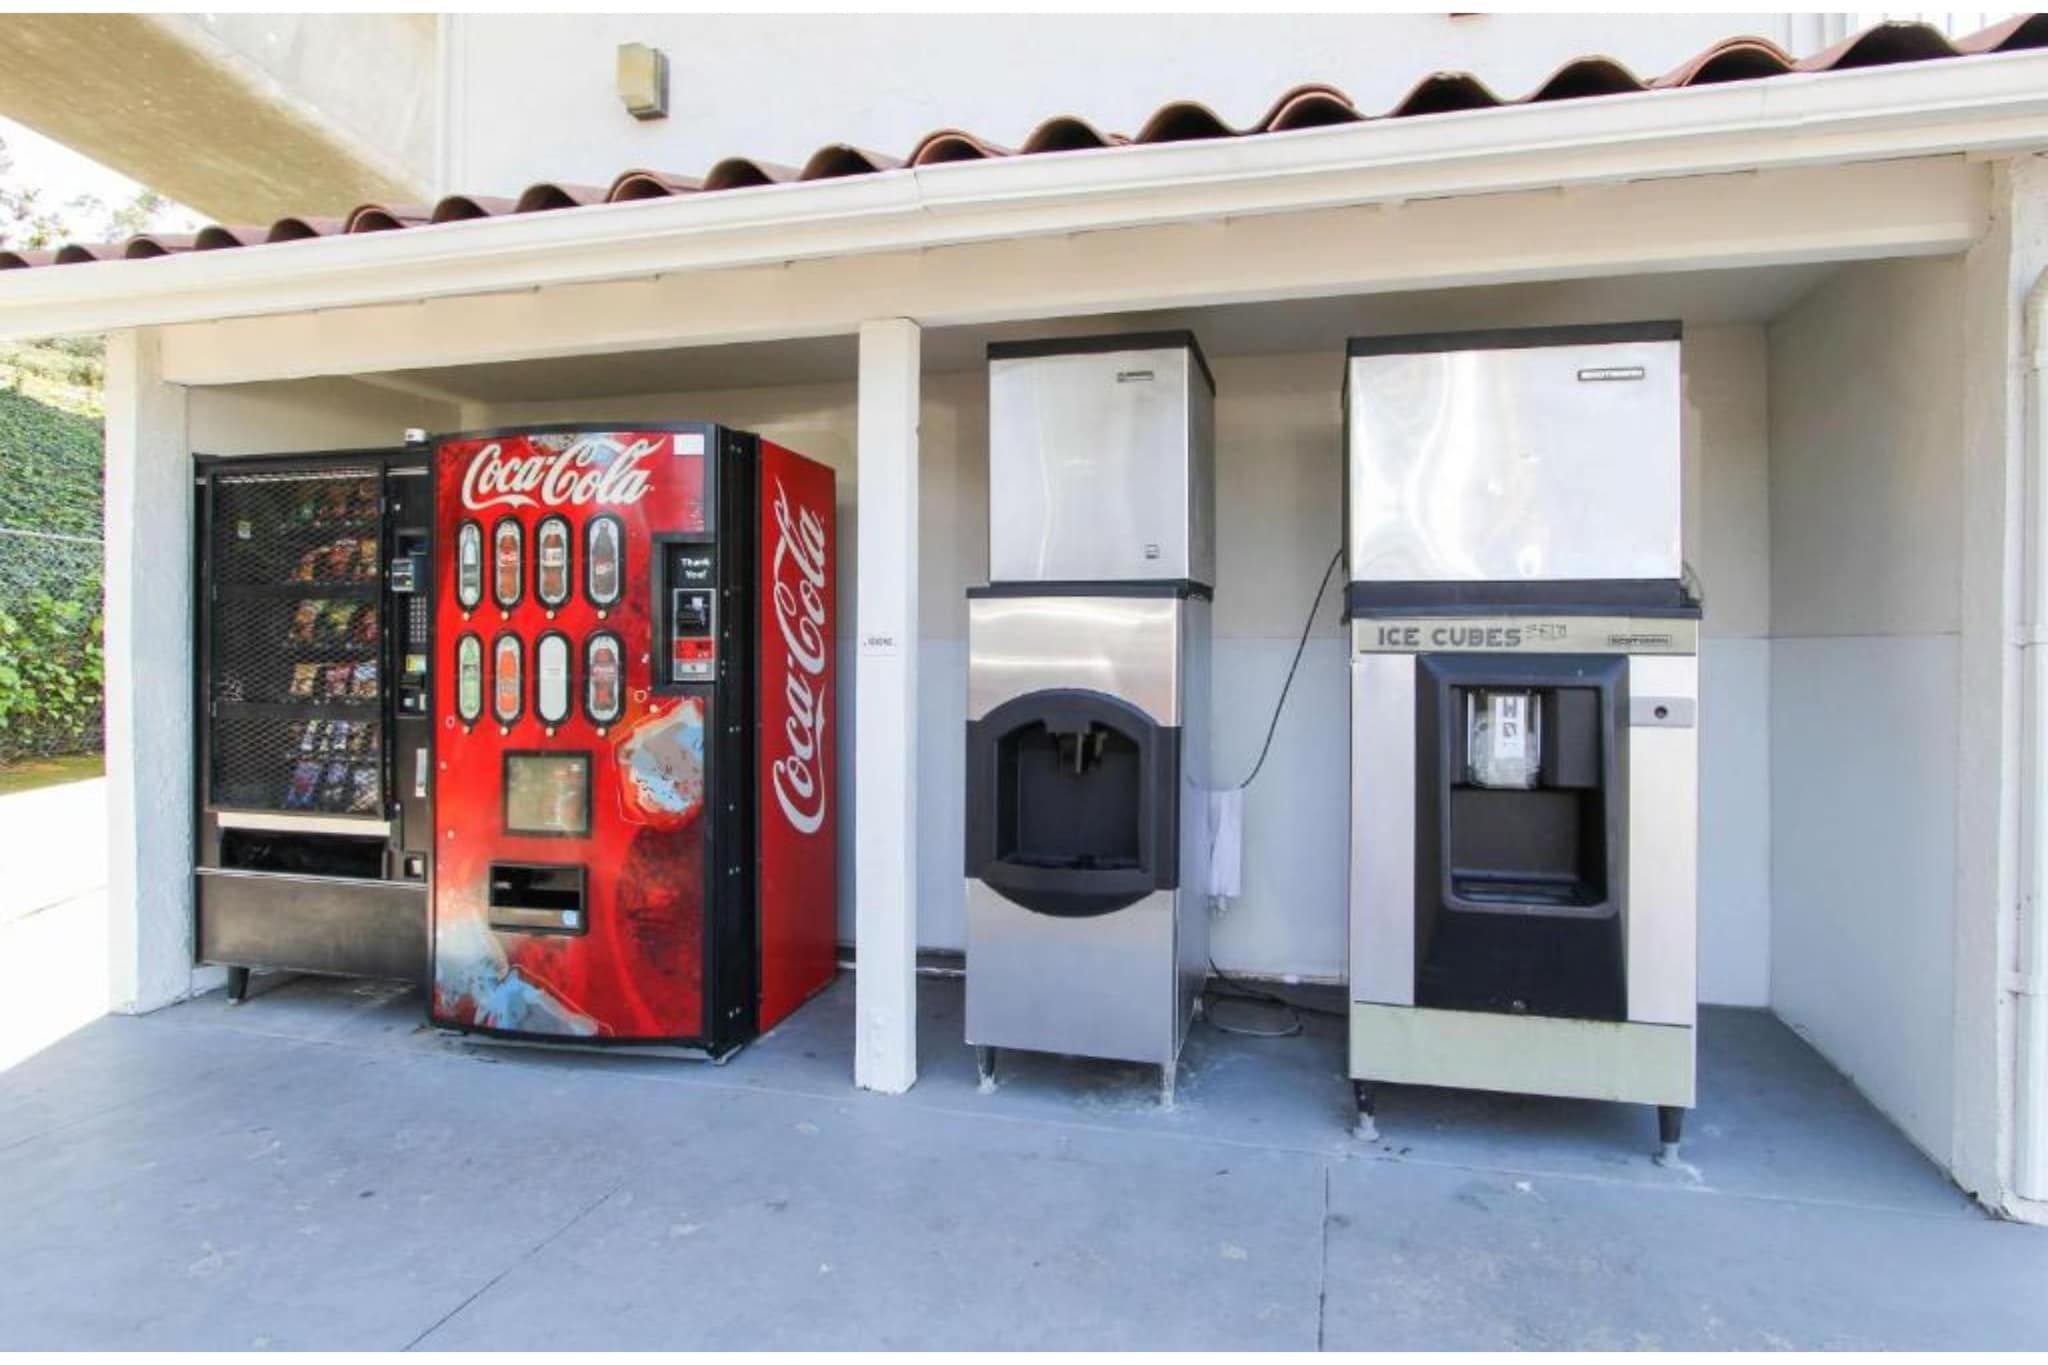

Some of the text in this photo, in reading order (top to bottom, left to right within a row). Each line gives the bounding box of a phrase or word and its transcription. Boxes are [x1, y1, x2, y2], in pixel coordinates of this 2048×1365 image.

[461, 436, 667, 510] Coca-Cola
[773, 475, 825, 834] Coca-Cola
[1377, 627, 1420, 646] ICE
[1431, 627, 1521, 648] CUBES
